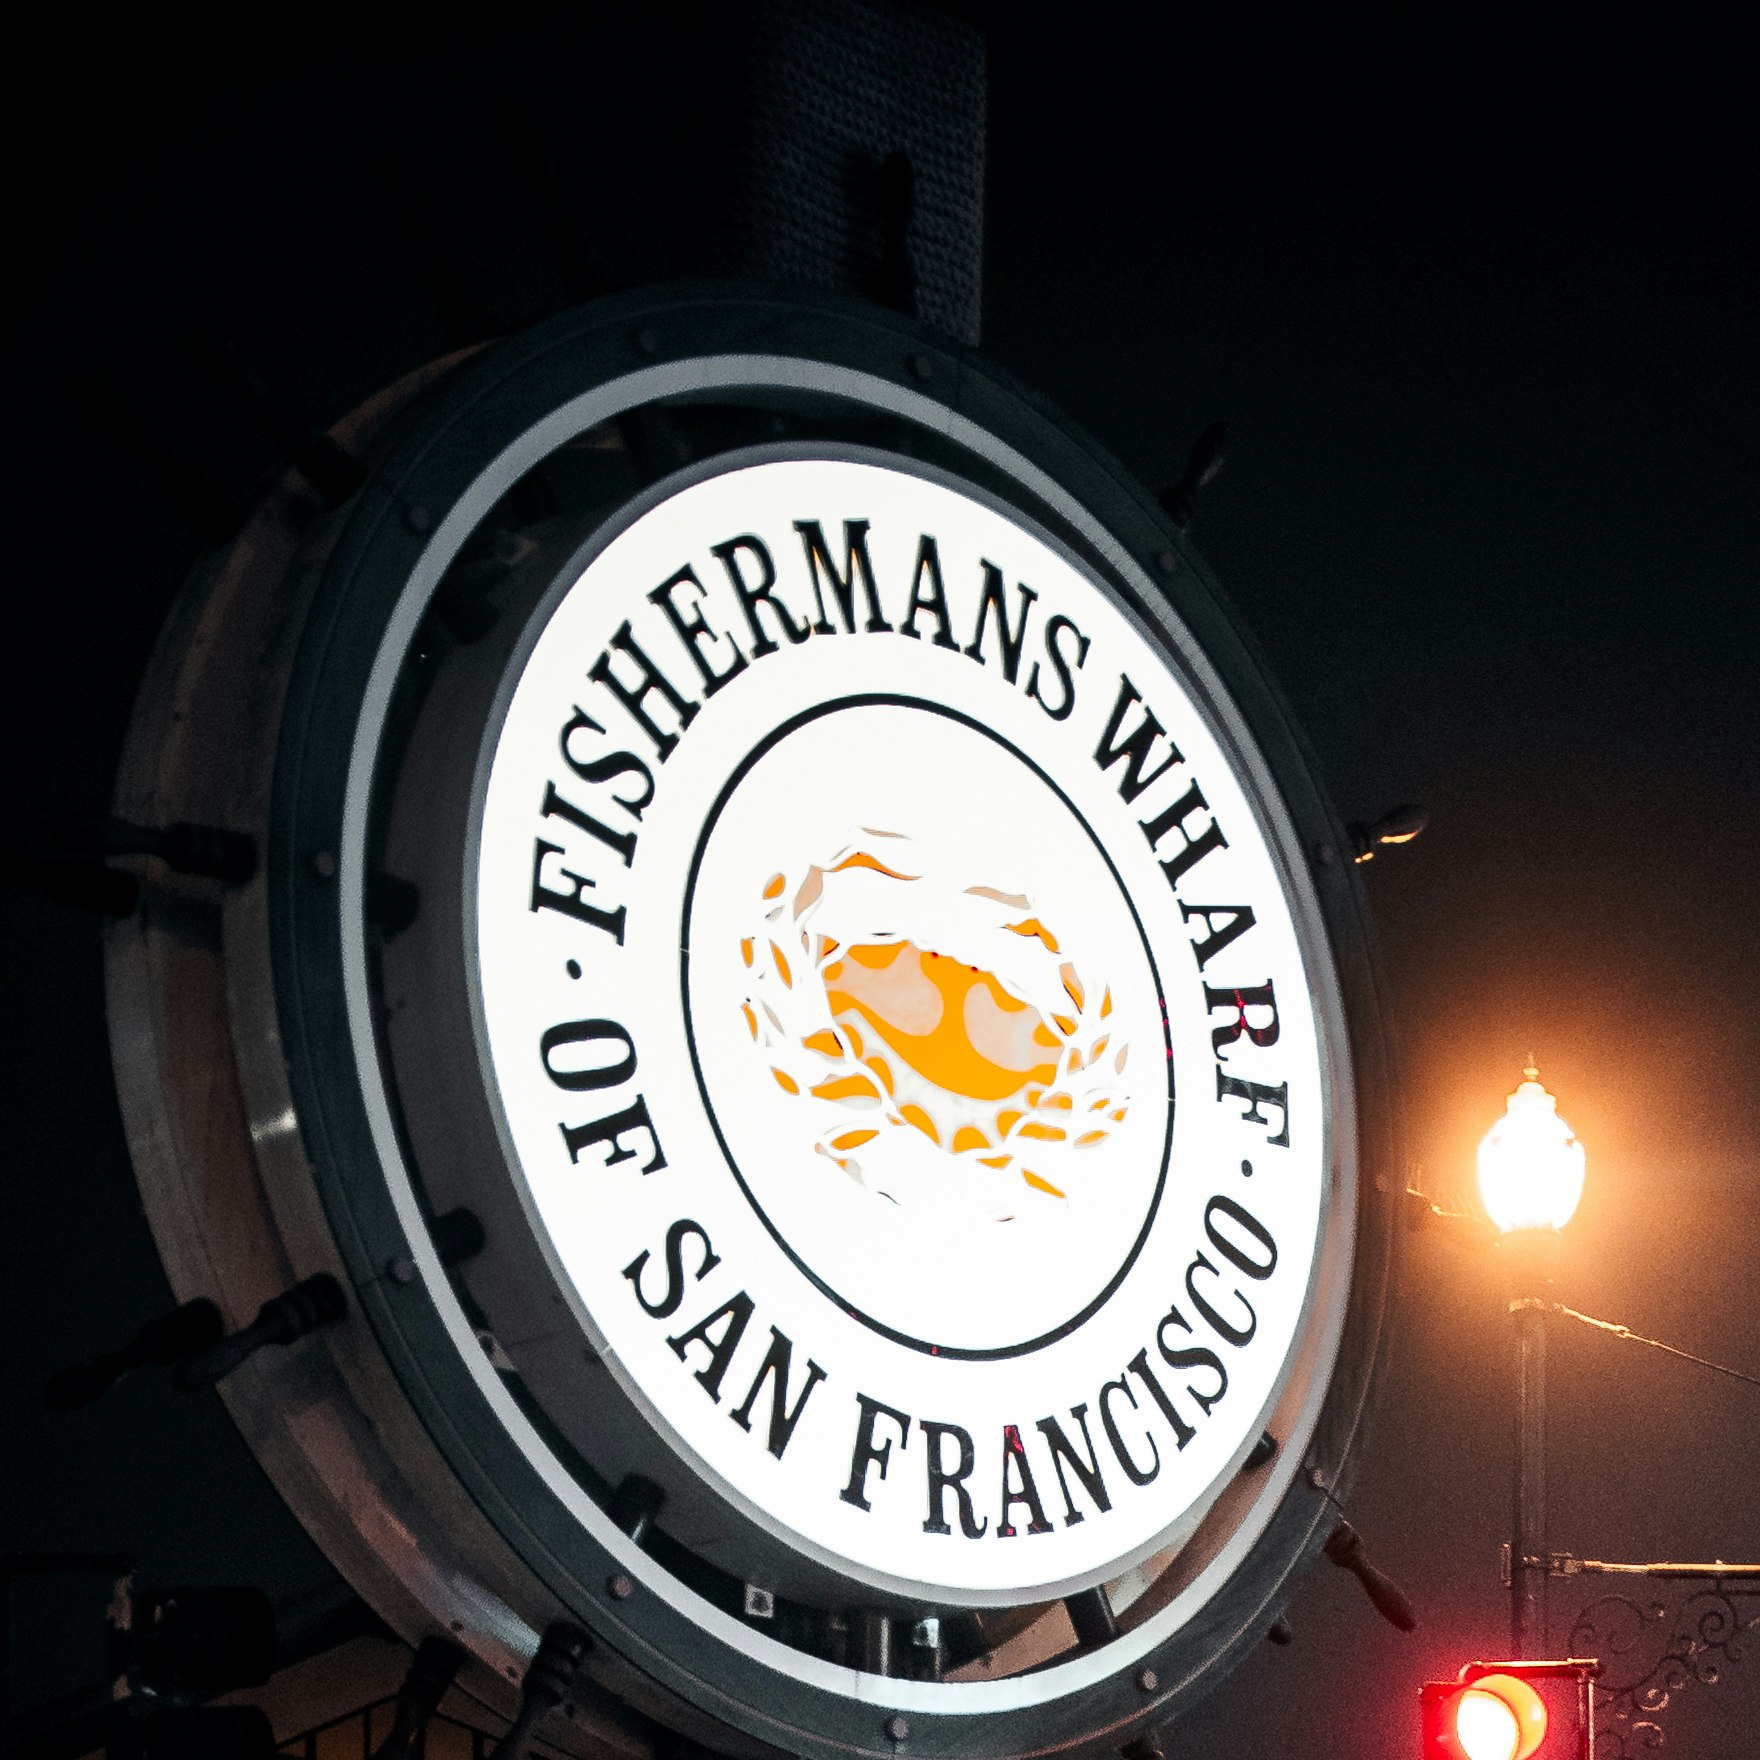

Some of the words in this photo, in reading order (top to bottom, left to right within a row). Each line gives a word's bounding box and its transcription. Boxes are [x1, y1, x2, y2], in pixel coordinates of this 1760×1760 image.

[529, 517, 1091, 947] FISHERMANS
[1092, 673, 1292, 1148] WHARF
[539, 1016, 668, 1178] OF
[622, 1218, 826, 1461] SAN
[840, 1194, 1279, 1540] FRANCISCO
